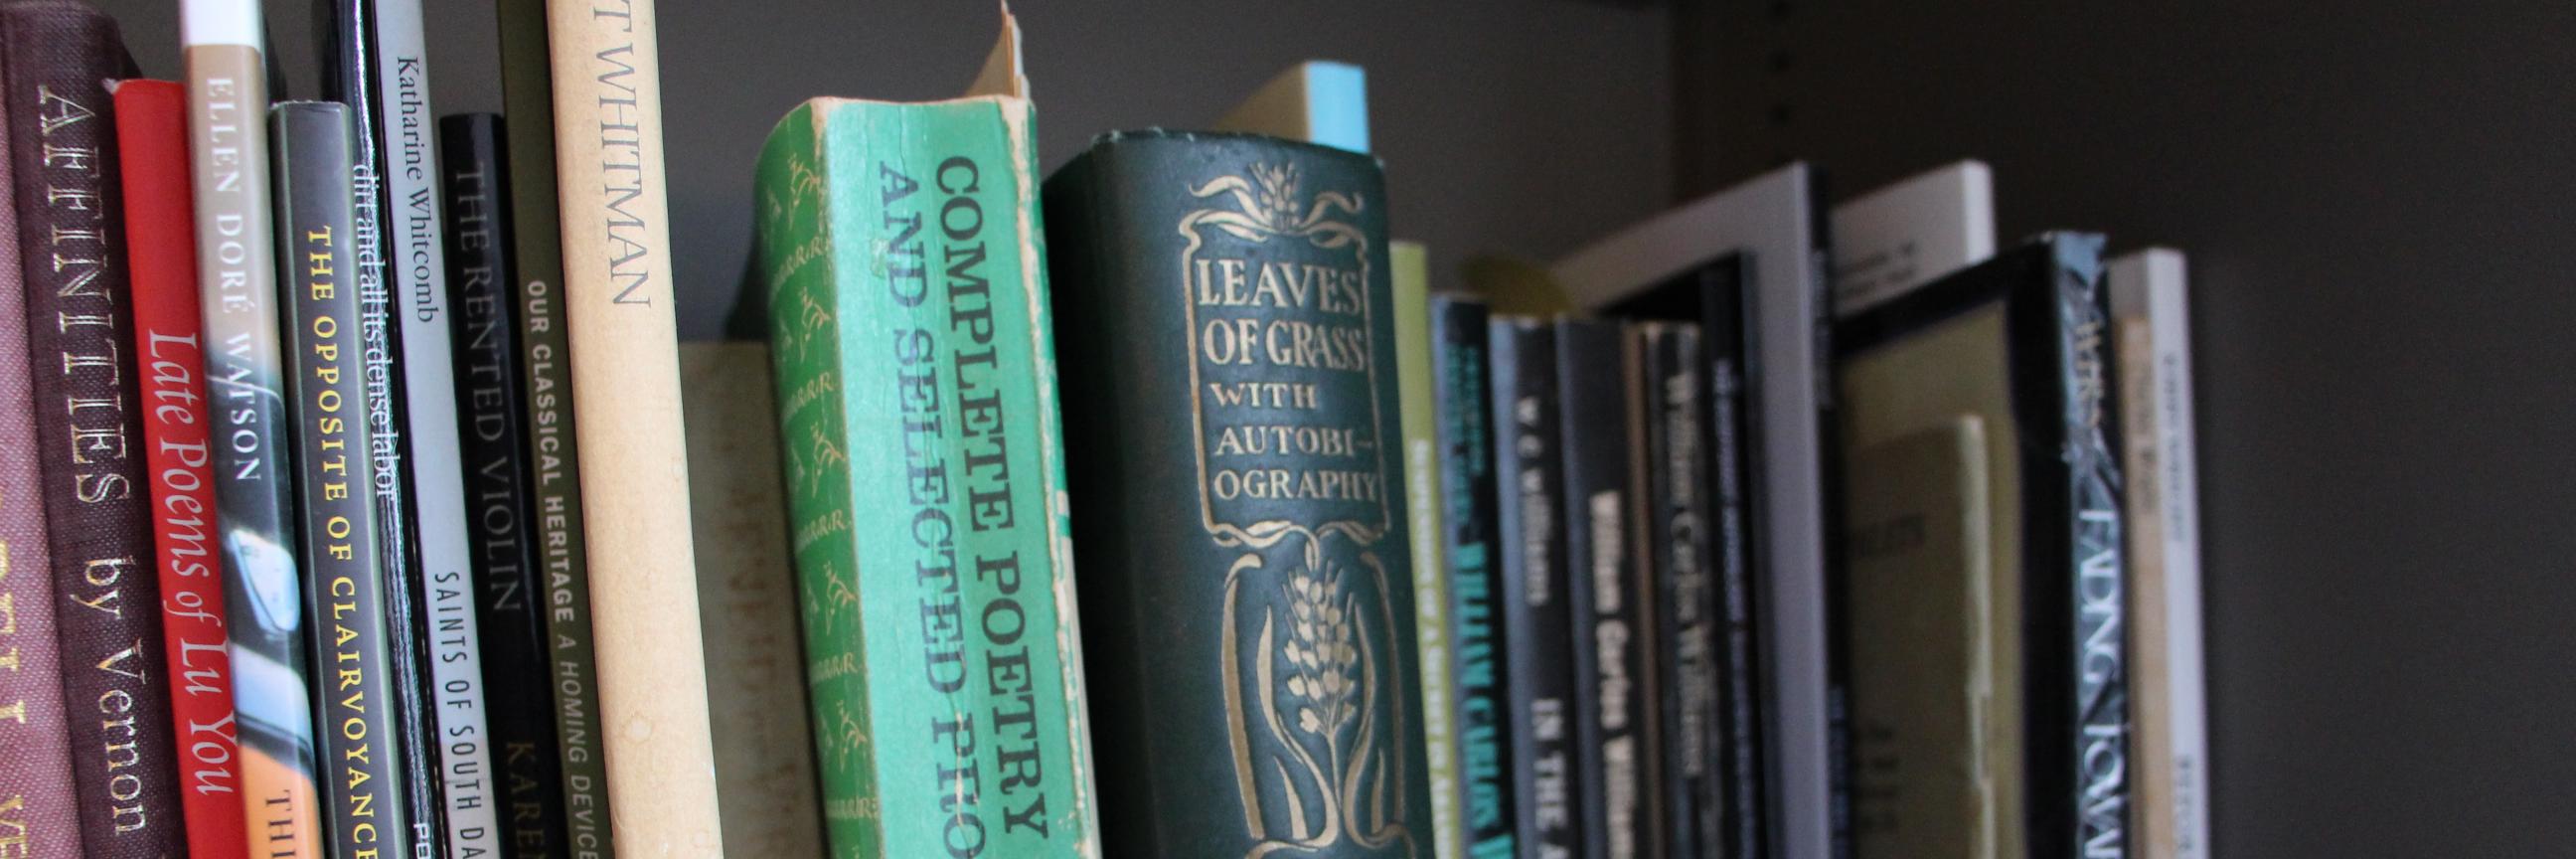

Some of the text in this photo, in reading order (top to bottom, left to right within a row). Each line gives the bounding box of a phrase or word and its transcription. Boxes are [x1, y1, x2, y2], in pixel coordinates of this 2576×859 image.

[398, 57, 439, 323] Katharine Whitcomb
[596, 43, 652, 308] WHITMAN
[308, 226, 333, 301] THE
[356, 218, 385, 266] and
[880, 160, 928, 308] AND
[208, 78, 260, 481] ELLEN DORÉ WATSON
[527, 280, 548, 333] OUR
[1196, 258, 1363, 316] LEAVES
[366, 347, 394, 427] dense
[456, 162, 521, 611] THE RENTED VIOLIN
[1204, 318, 1367, 372] OF GRASS
[313, 315, 348, 500] OPPOSITE
[532, 343, 563, 485] CLASSICAL
[1209, 381, 1319, 410] WITH
[38, 85, 147, 835] AFFINITIES by Vernon
[372, 430, 400, 500] labor
[1214, 425, 1373, 457] AUTOBI-
[894, 328, 968, 694] SELECTED
[936, 156, 1049, 839] COMPLETE POETRY
[1213, 468, 1379, 503] OGRAPHY
[149, 327, 239, 796] Late Poems of Lu You
[326, 517, 356, 560] OF
[543, 496, 575, 623] HERITAGE
[434, 571, 468, 663] SAINTS
[558, 634, 576, 649] A
[445, 680, 472, 709] OF
[560, 660, 588, 764] HOMING
[449, 726, 482, 810] SOUTH
